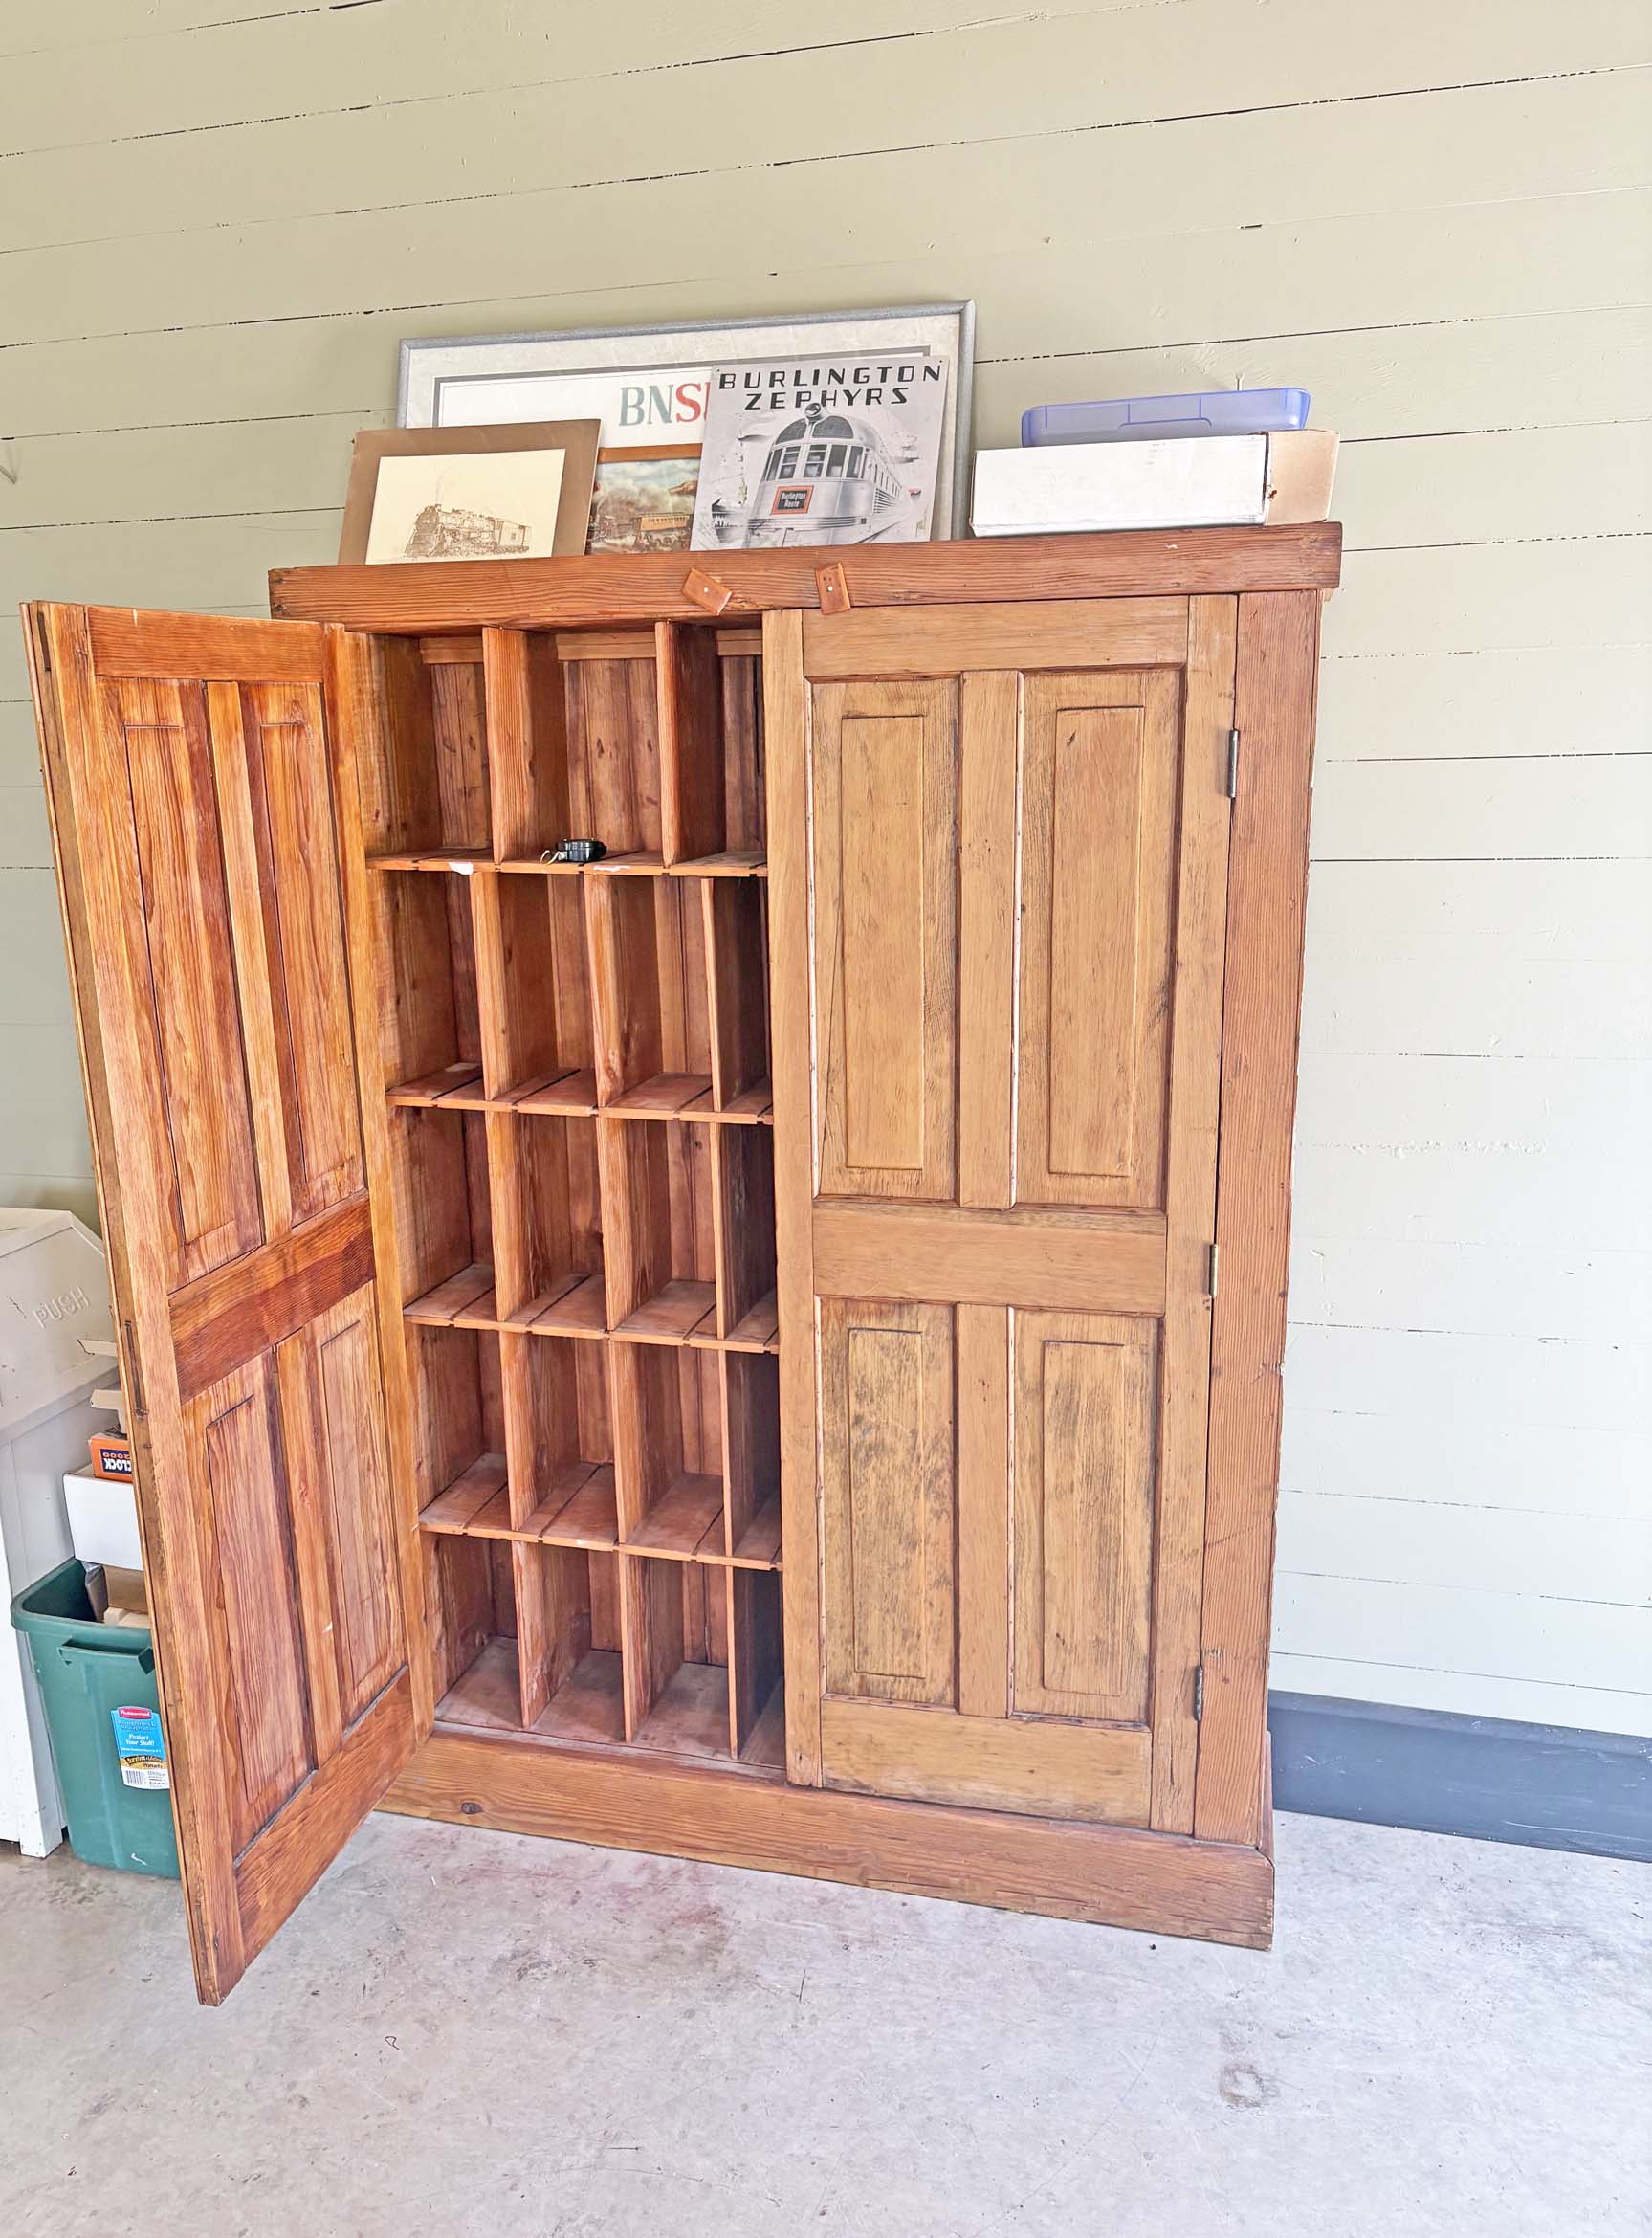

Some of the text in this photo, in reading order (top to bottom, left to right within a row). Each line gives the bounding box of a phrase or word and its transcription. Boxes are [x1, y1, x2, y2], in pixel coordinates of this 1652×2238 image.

[718, 365, 941, 389] BURLINGTON
[744, 387, 909, 410] ZEPHYRS
[33, 1286, 91, 1329] PUSH
